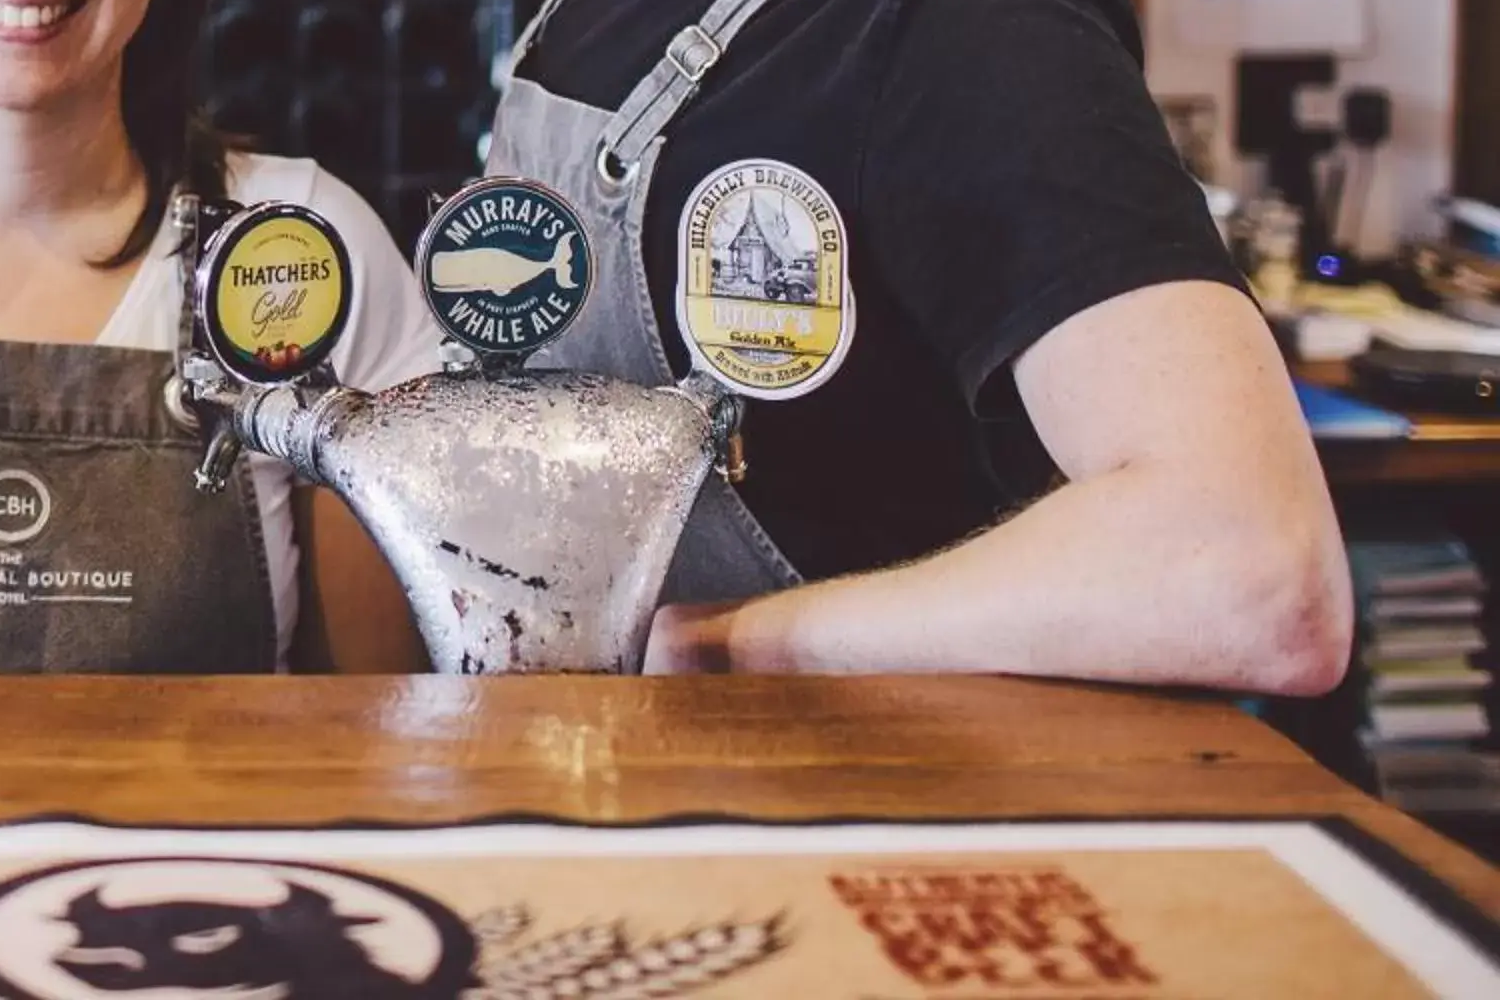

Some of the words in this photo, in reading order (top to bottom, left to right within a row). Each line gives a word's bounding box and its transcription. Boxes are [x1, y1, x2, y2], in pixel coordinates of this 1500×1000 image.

[445, 196, 565, 246] MURRAY'S
[691, 172, 744, 249] HILLBILLY
[755, 169, 831, 222] BREWING
[231, 259, 331, 287] THATCHERS
[251, 288, 308, 339] Gold
[448, 298, 525, 343] WHALE
[531, 292, 570, 335] ALE
[27, 571, 133, 588] BOUTIQUE
